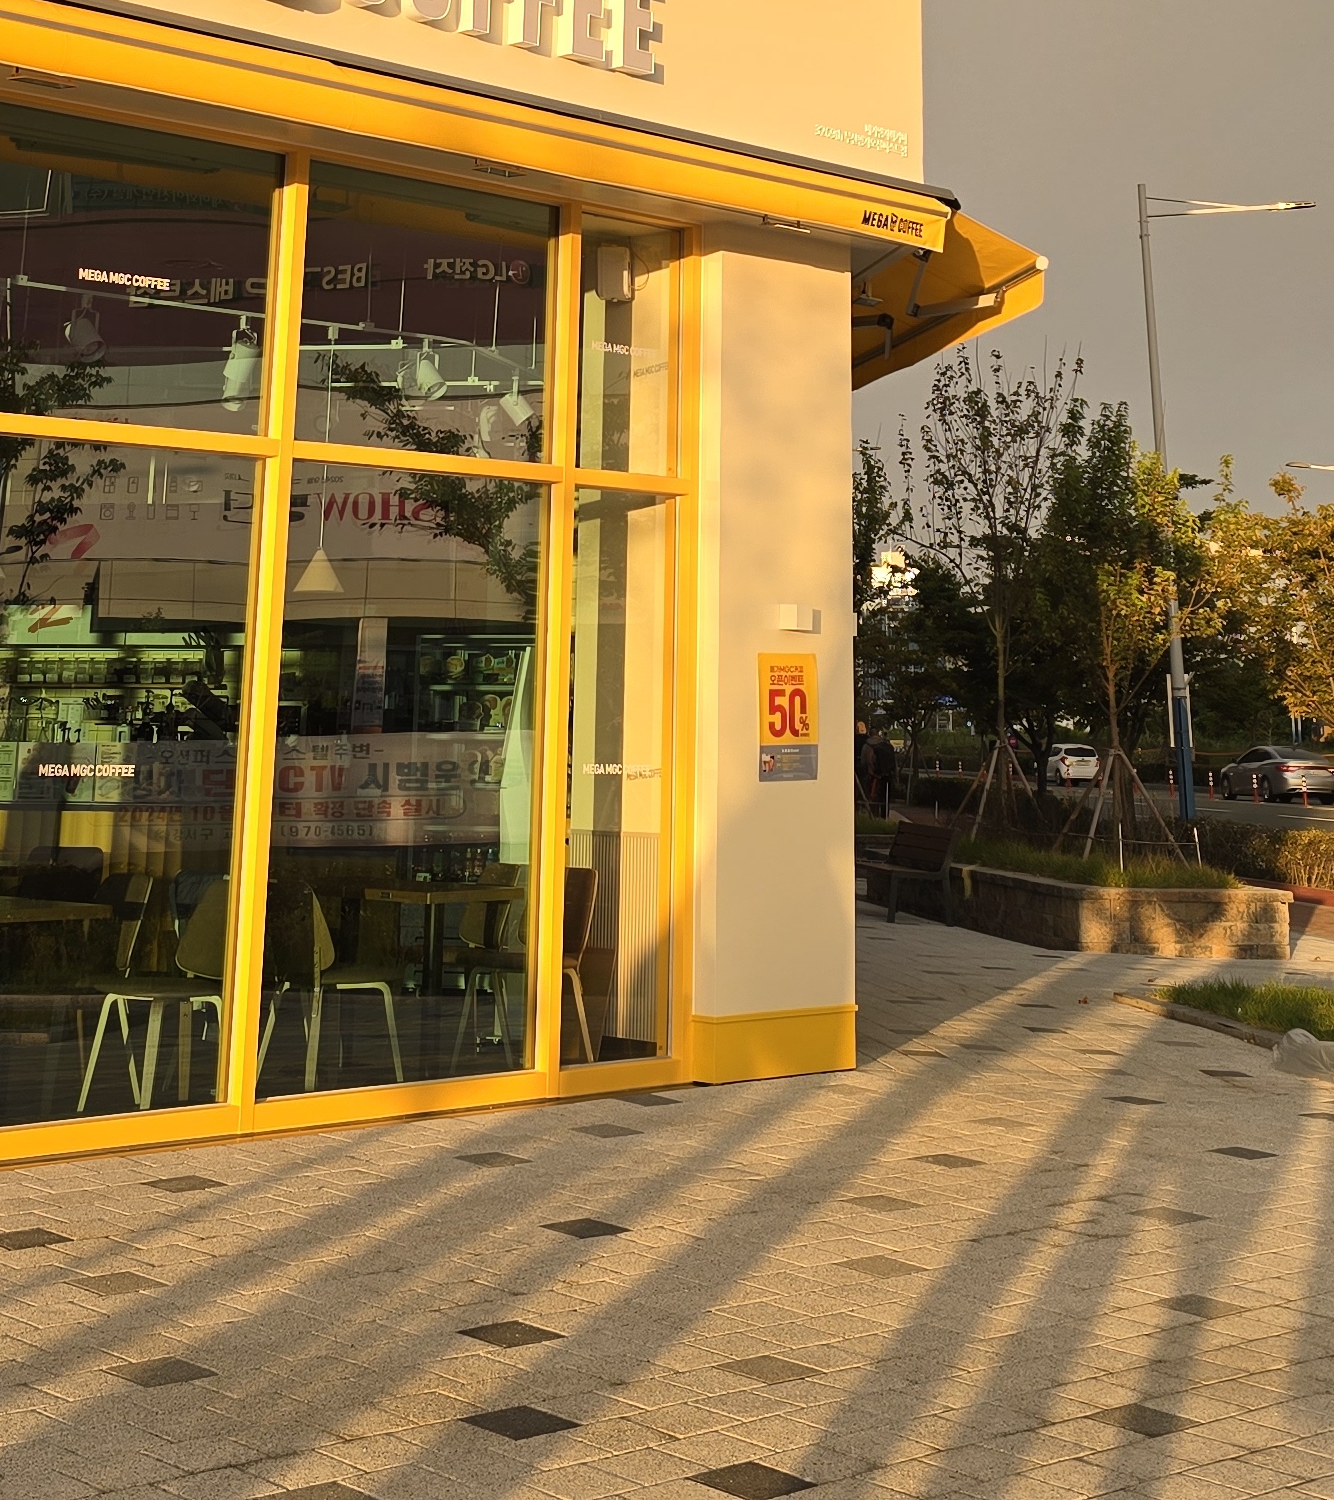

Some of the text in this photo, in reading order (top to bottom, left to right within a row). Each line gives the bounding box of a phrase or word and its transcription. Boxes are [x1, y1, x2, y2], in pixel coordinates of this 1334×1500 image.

[861, 209, 924, 238] MEGA COFFEE
[78, 267, 170, 291] MEGA MGC COFFEE
[591, 340, 612, 353] MEGA
[613, 343, 630, 355] MGC
[770, 674, 804, 686] 오픈이벤트
[38, 763, 136, 777] MEGA MGC COFFEE
[583, 763, 606, 775] MEGA
[605, 763, 623, 775] MGC
[278, 764, 350, 793] CTV
